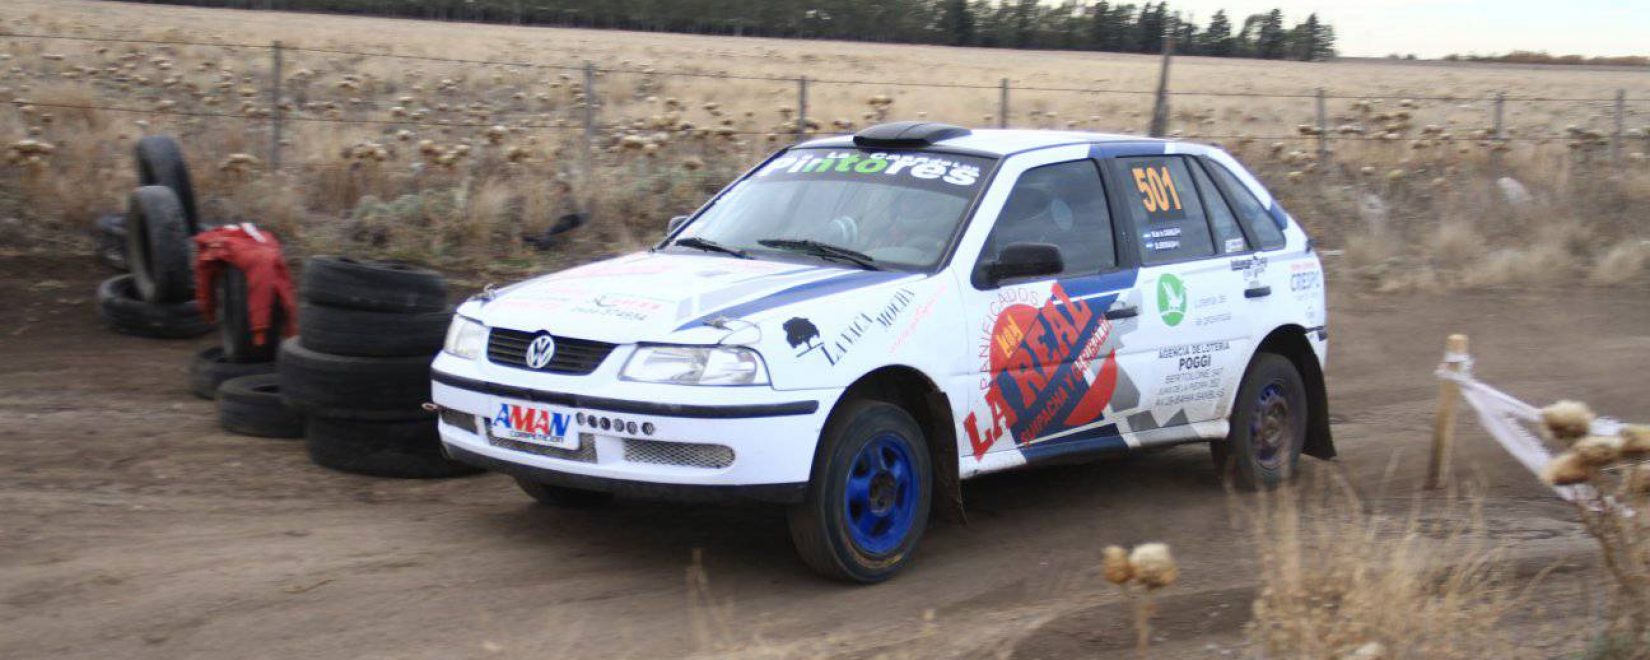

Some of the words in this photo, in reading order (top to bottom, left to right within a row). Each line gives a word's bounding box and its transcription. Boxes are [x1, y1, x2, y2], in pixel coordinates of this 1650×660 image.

[756, 155, 979, 186] Pintores
[1131, 166, 1182, 213] 501
[876, 287, 916, 329] MOCHA
[820, 342, 847, 366] LA
[979, 286, 1040, 391] PANIFICADOS
[1158, 343, 1190, 359] AGENCIA
[963, 379, 1019, 463] LA
[1006, 283, 1093, 409] REAL
[1179, 354, 1211, 371] POGGI
[493, 403, 571, 437] AMAN
